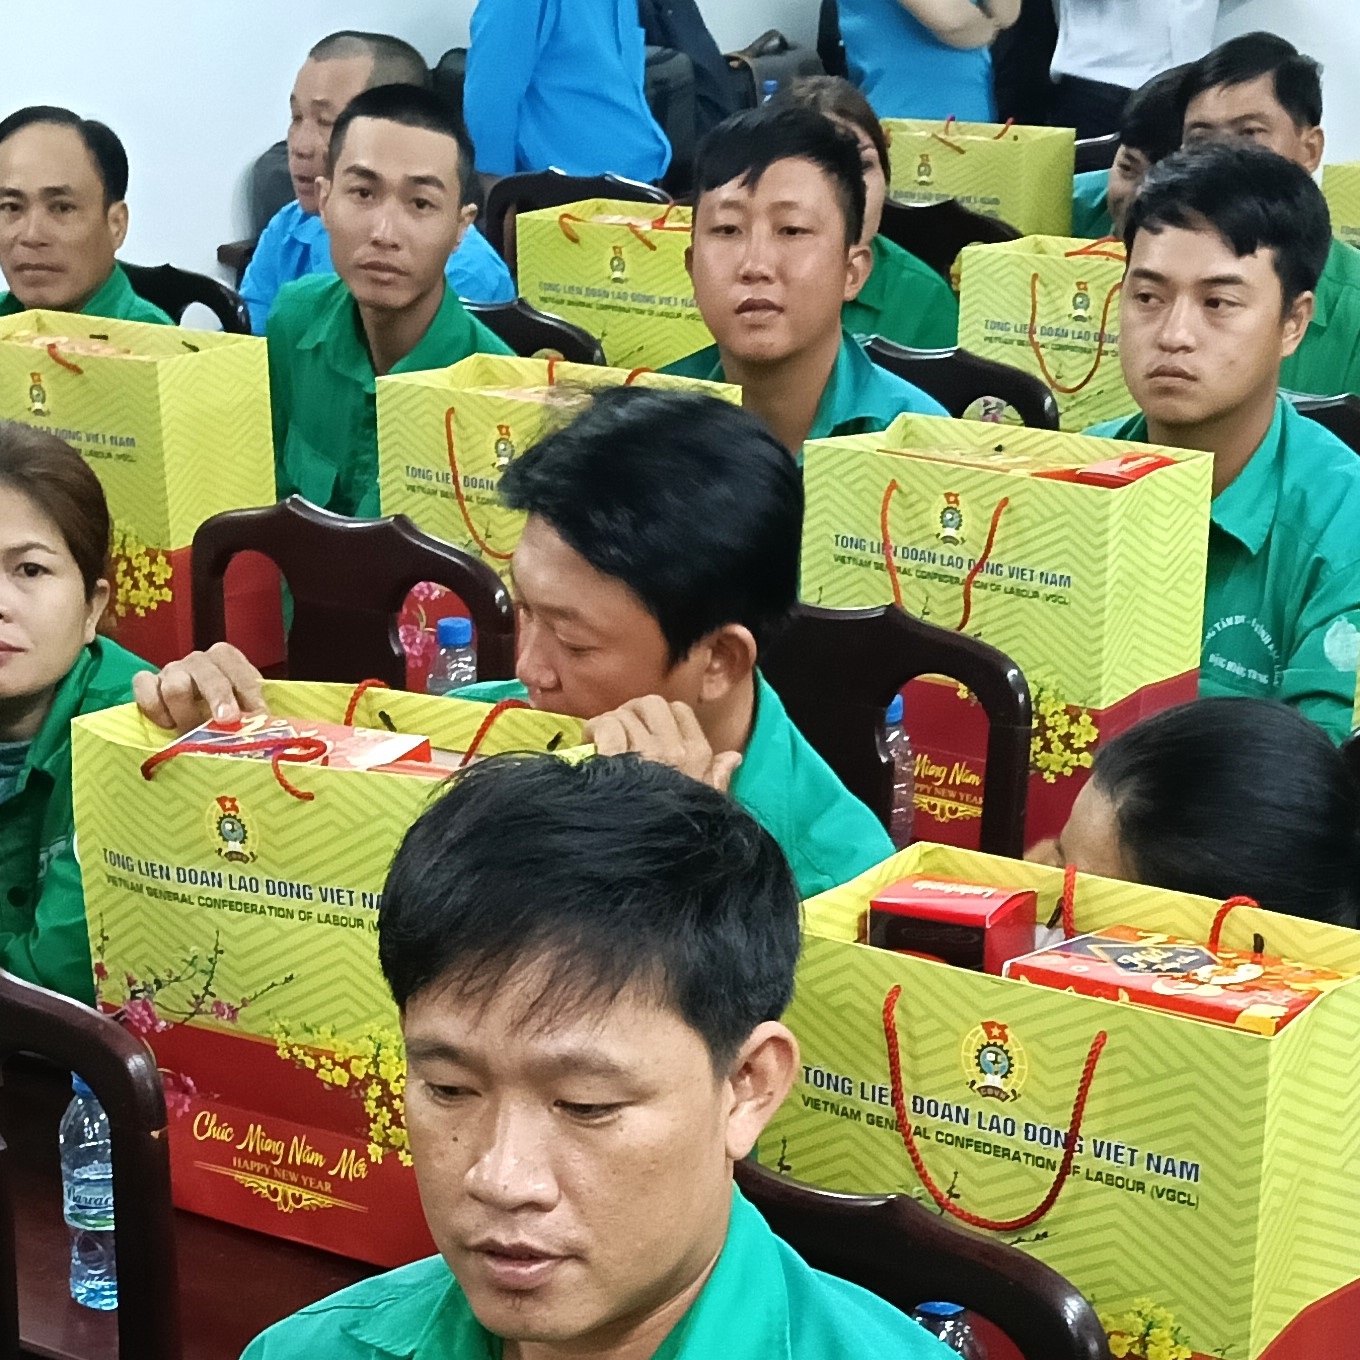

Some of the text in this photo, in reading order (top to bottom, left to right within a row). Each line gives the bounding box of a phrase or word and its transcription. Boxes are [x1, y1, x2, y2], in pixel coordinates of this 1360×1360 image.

[228, 873, 260, 893] LAO
[197, 896, 295, 921] CONFEDERATION
[298, 910, 313, 922] OF
[317, 913, 365, 930] LABOUR
[193, 1110, 235, 1142] Chúc
[236, 1123, 285, 1166] Mừng
[288, 1134, 326, 1168] Năm
[802, 1095, 862, 1123] VIETNAM
[935, 1130, 1057, 1172] CONFEDERATION
[1085, 1168, 1146, 1195] LABOUR
[977, 1111, 1016, 1137] LAO
[1145, 1152, 1201, 1183] NAM
[232, 1156, 332, 1194] HAPPY NEW YEAR
